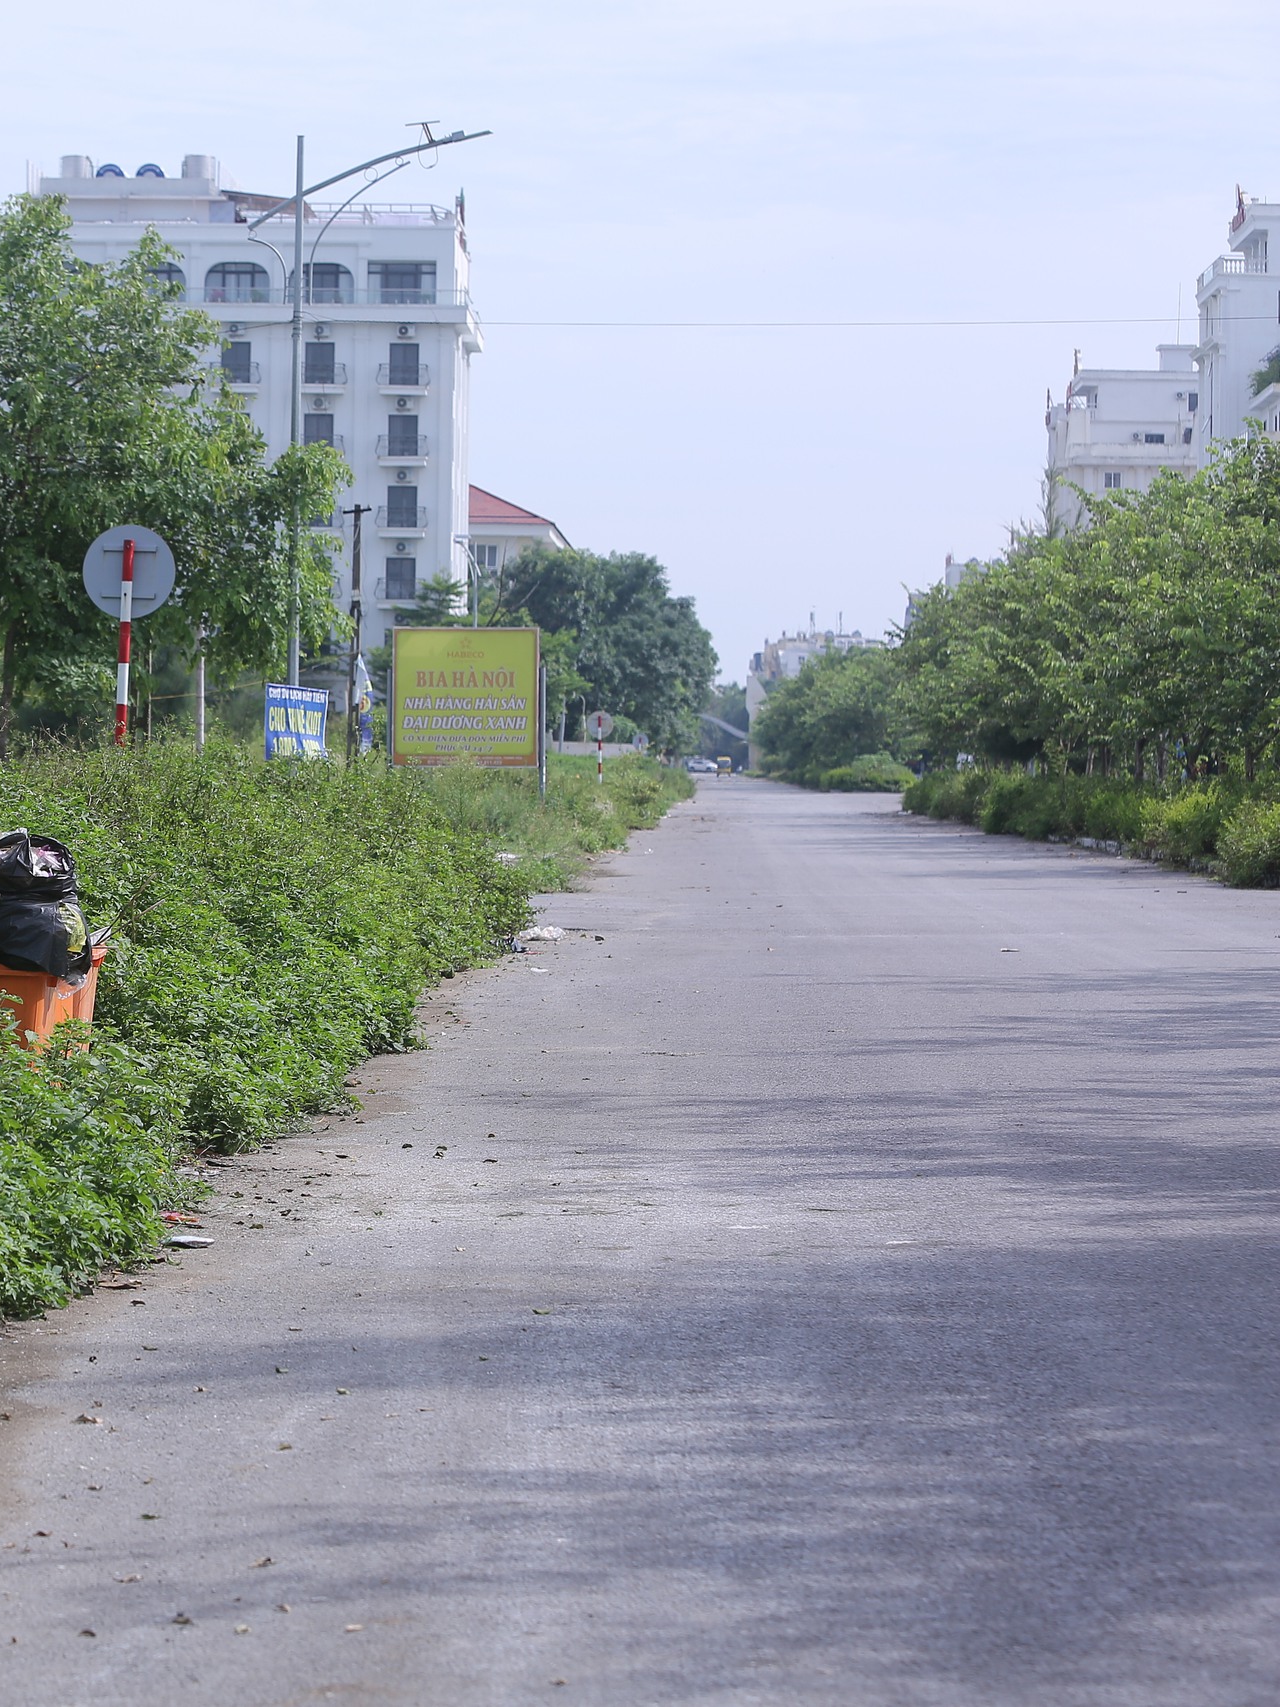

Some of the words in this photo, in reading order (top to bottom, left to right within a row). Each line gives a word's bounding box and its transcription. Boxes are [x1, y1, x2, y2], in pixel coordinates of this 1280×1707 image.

[447, 651, 485, 659] HABECO
[416, 671, 448, 689] BIA
[452, 666, 479, 689] HÀ
[482, 665, 516, 692] NỘI
[404, 695, 432, 710] NHÀ
[435, 695, 472, 710] HÀNG
[474, 694, 499, 710] HẢI
[500, 694, 526, 710] SẢN
[269, 706, 286, 732] CHO
[402, 716, 429, 733] ĐẠI
[431, 715, 483, 730] DƯƠNG
[485, 716, 527, 730] XANH
